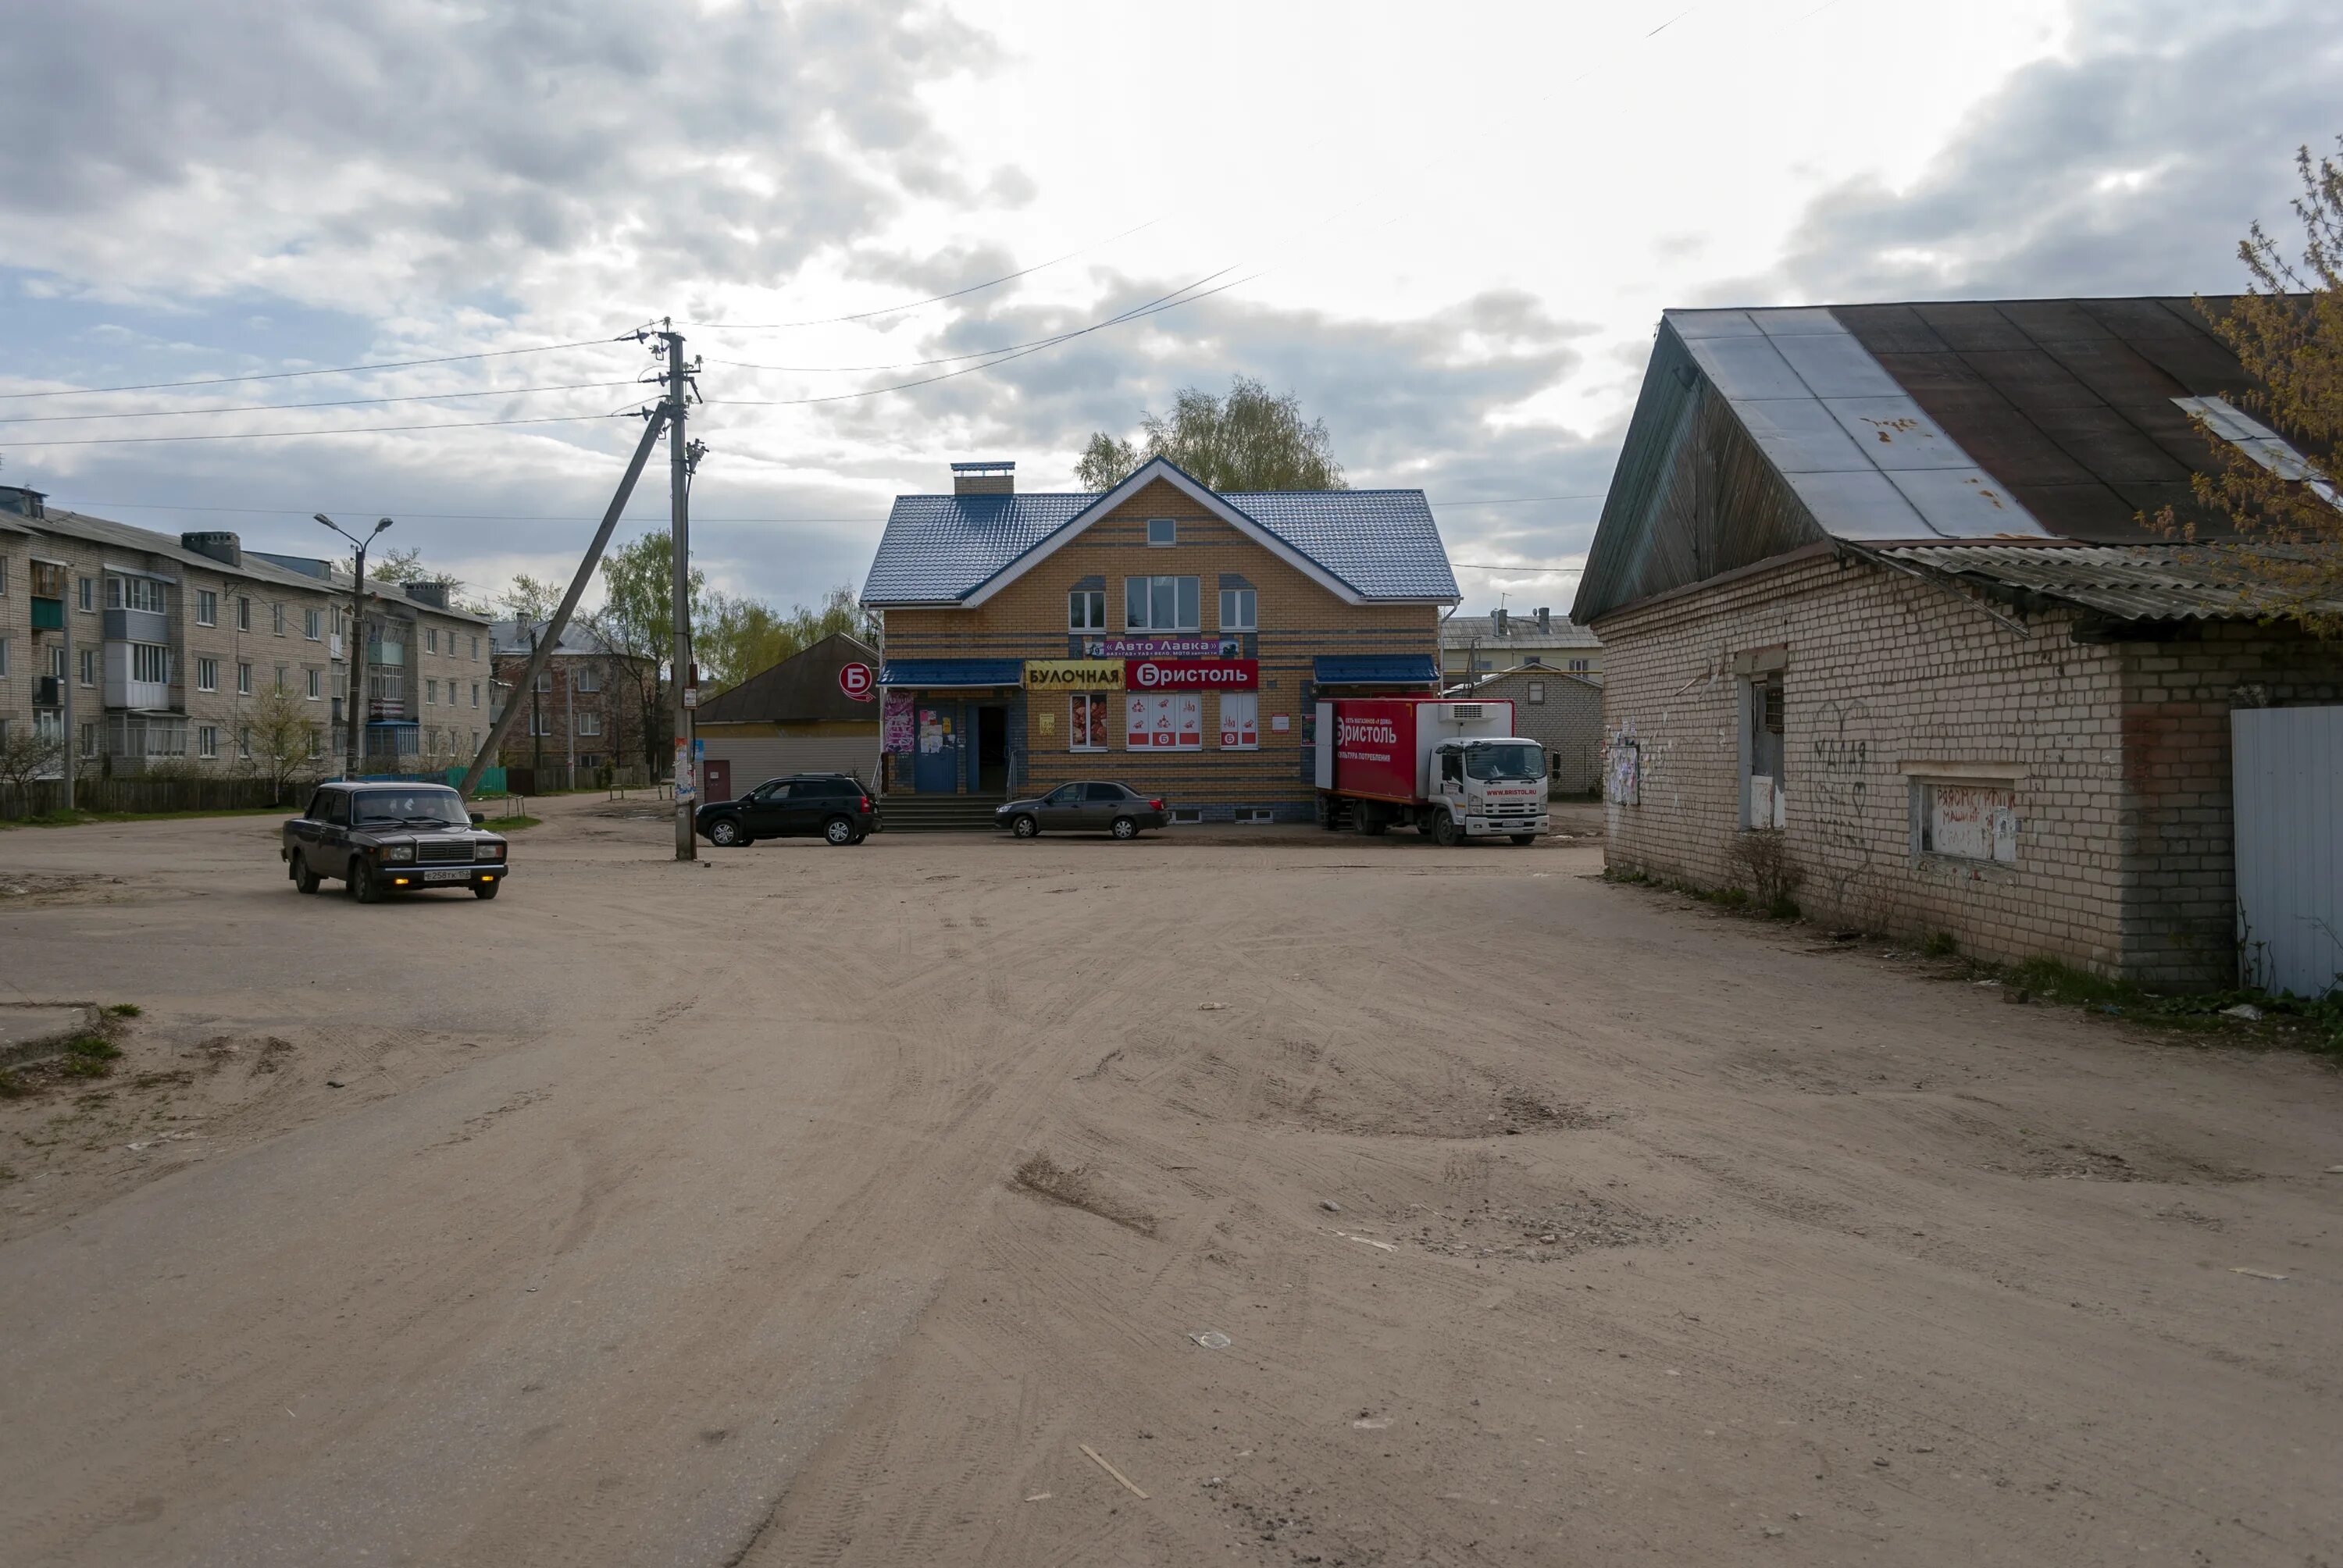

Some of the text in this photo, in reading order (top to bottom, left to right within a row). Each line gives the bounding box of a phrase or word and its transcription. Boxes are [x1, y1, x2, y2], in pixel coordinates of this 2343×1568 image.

[847, 668, 866, 689] Б
[1029, 669, 1119, 683] БУЛОЧНАЯ
[1137, 663, 1248, 686] Бристоль
[1358, 752, 1391, 762] ПОТРЕБЛЕНИЯ
